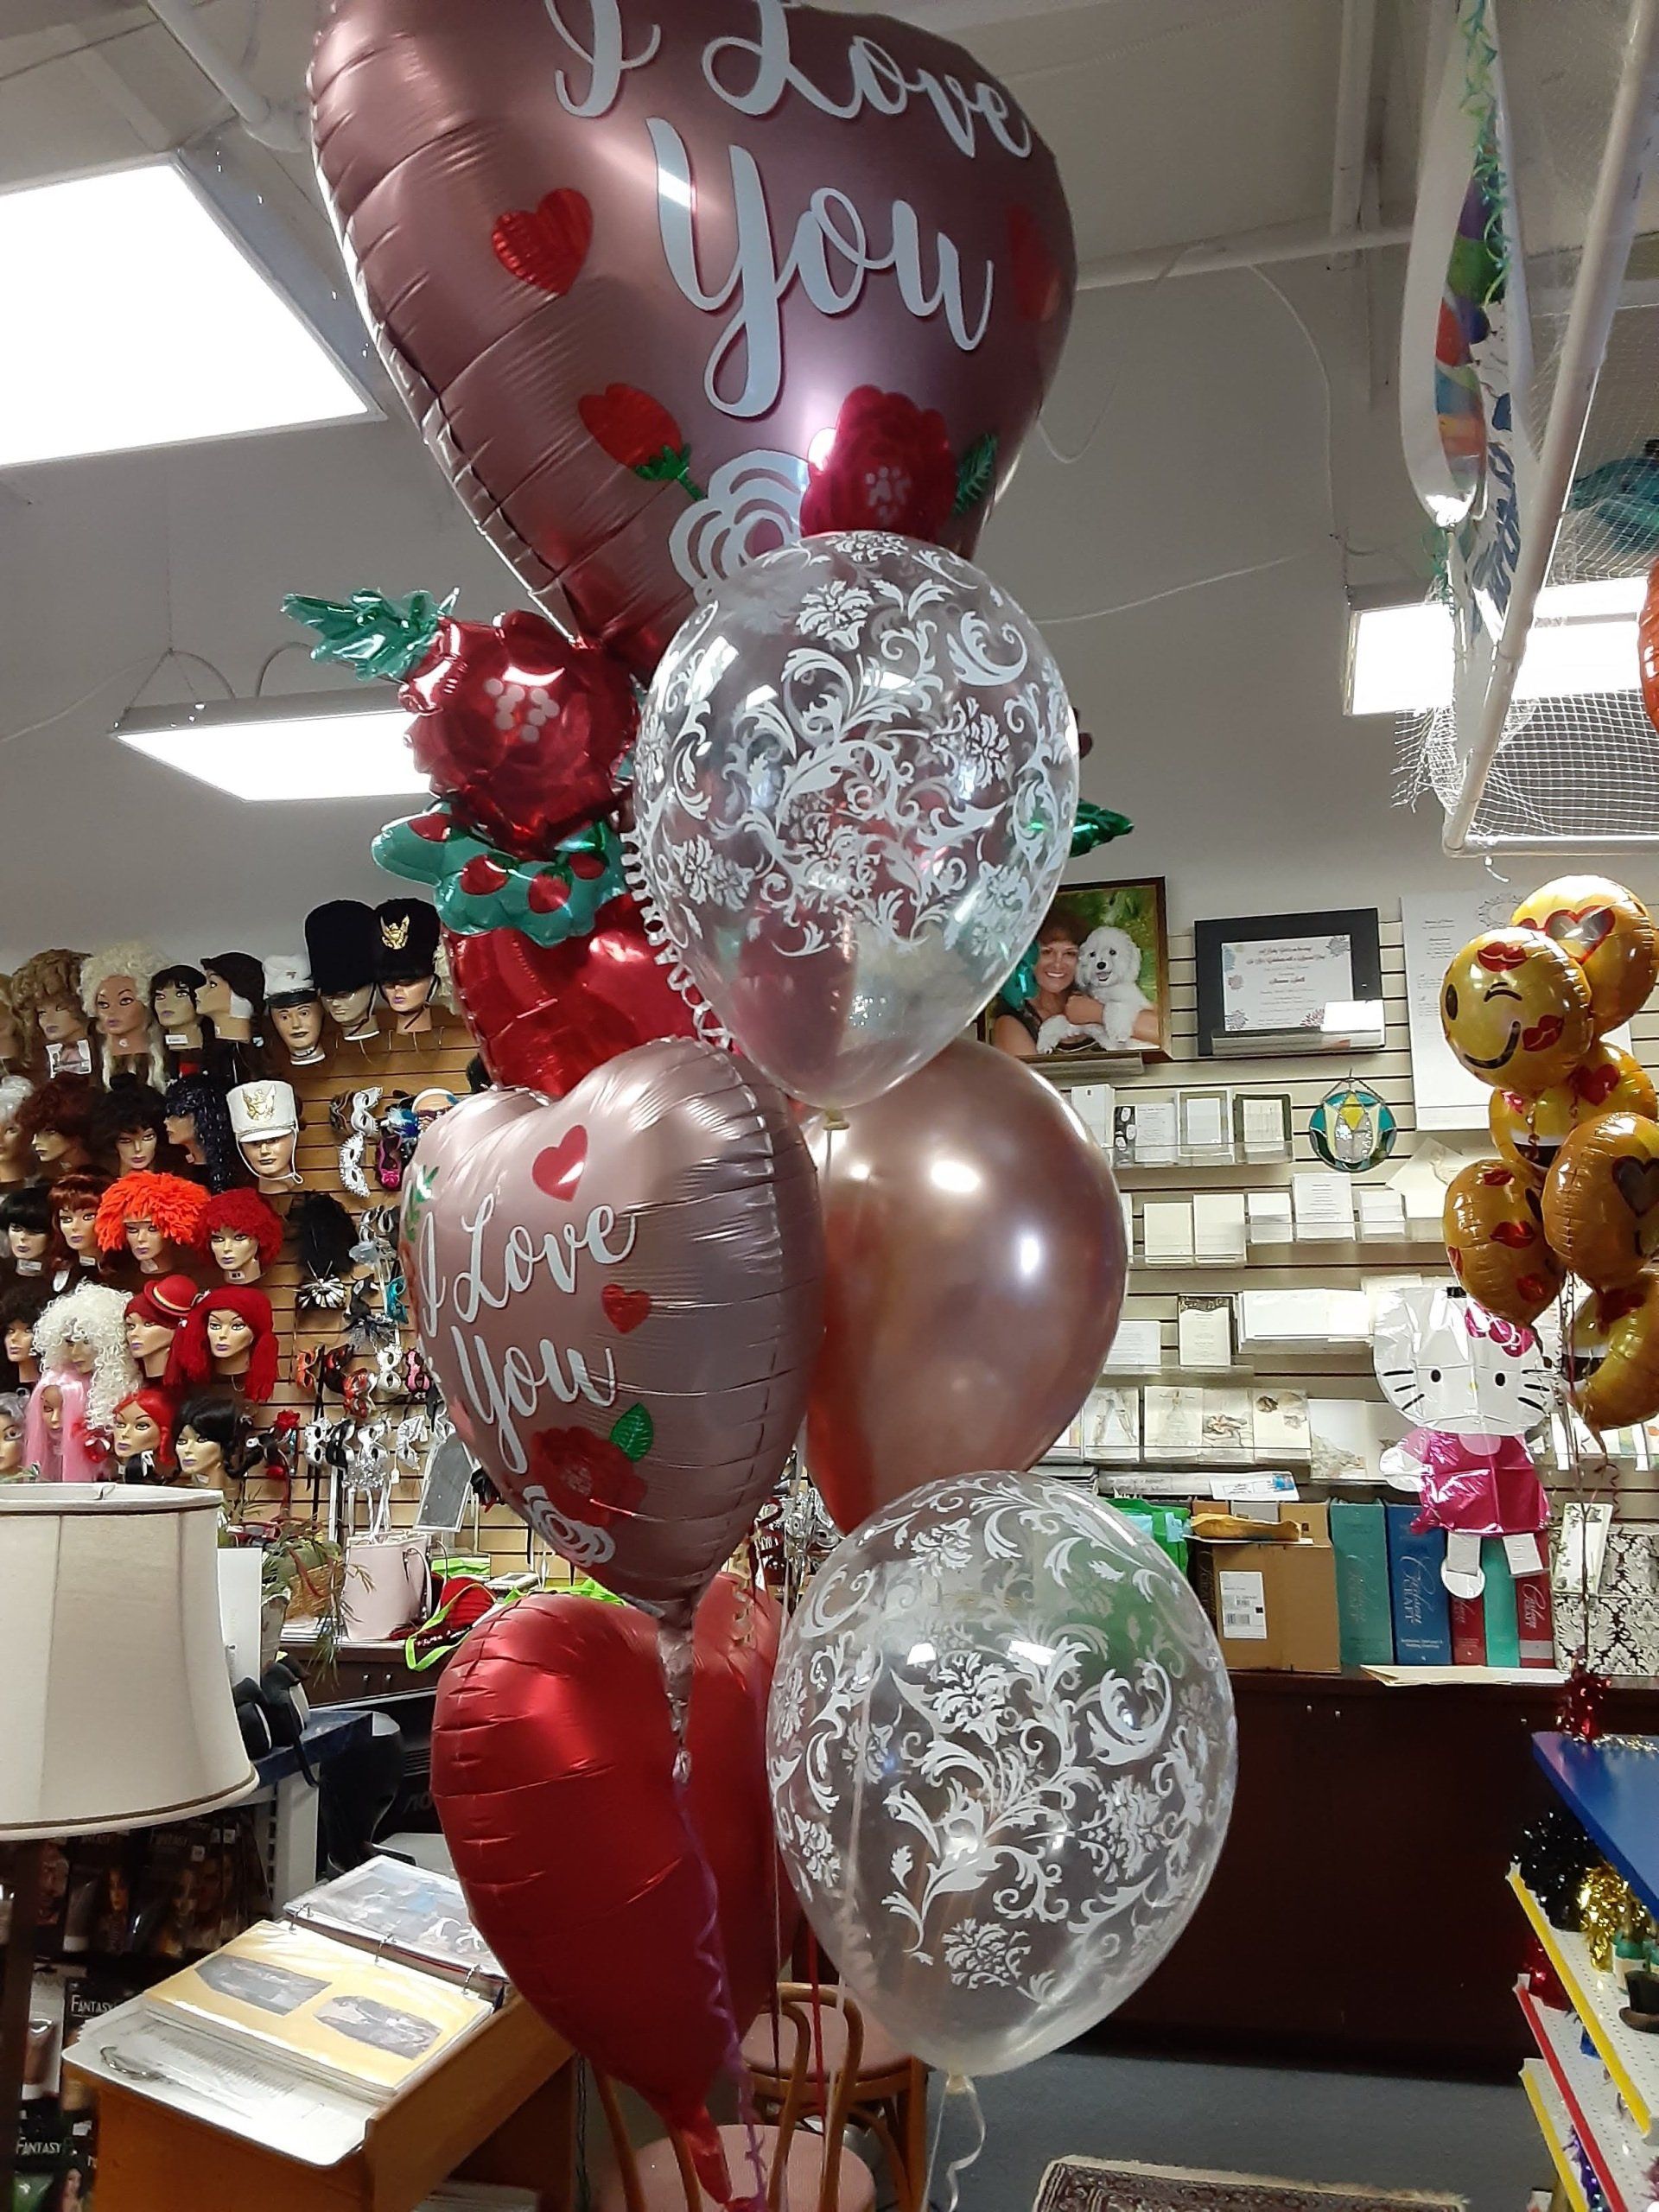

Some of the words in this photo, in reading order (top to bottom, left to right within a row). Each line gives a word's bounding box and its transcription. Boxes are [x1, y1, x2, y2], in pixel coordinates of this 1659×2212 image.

[547, 0, 660, 118] I
[702, 0, 1033, 159] Love
[645, 116, 995, 419] You
[418, 1211, 448, 1338] I
[453, 1192, 636, 1325] Love
[450, 1325, 616, 1475] You
[16, 2137, 63, 2157] FANTASY
